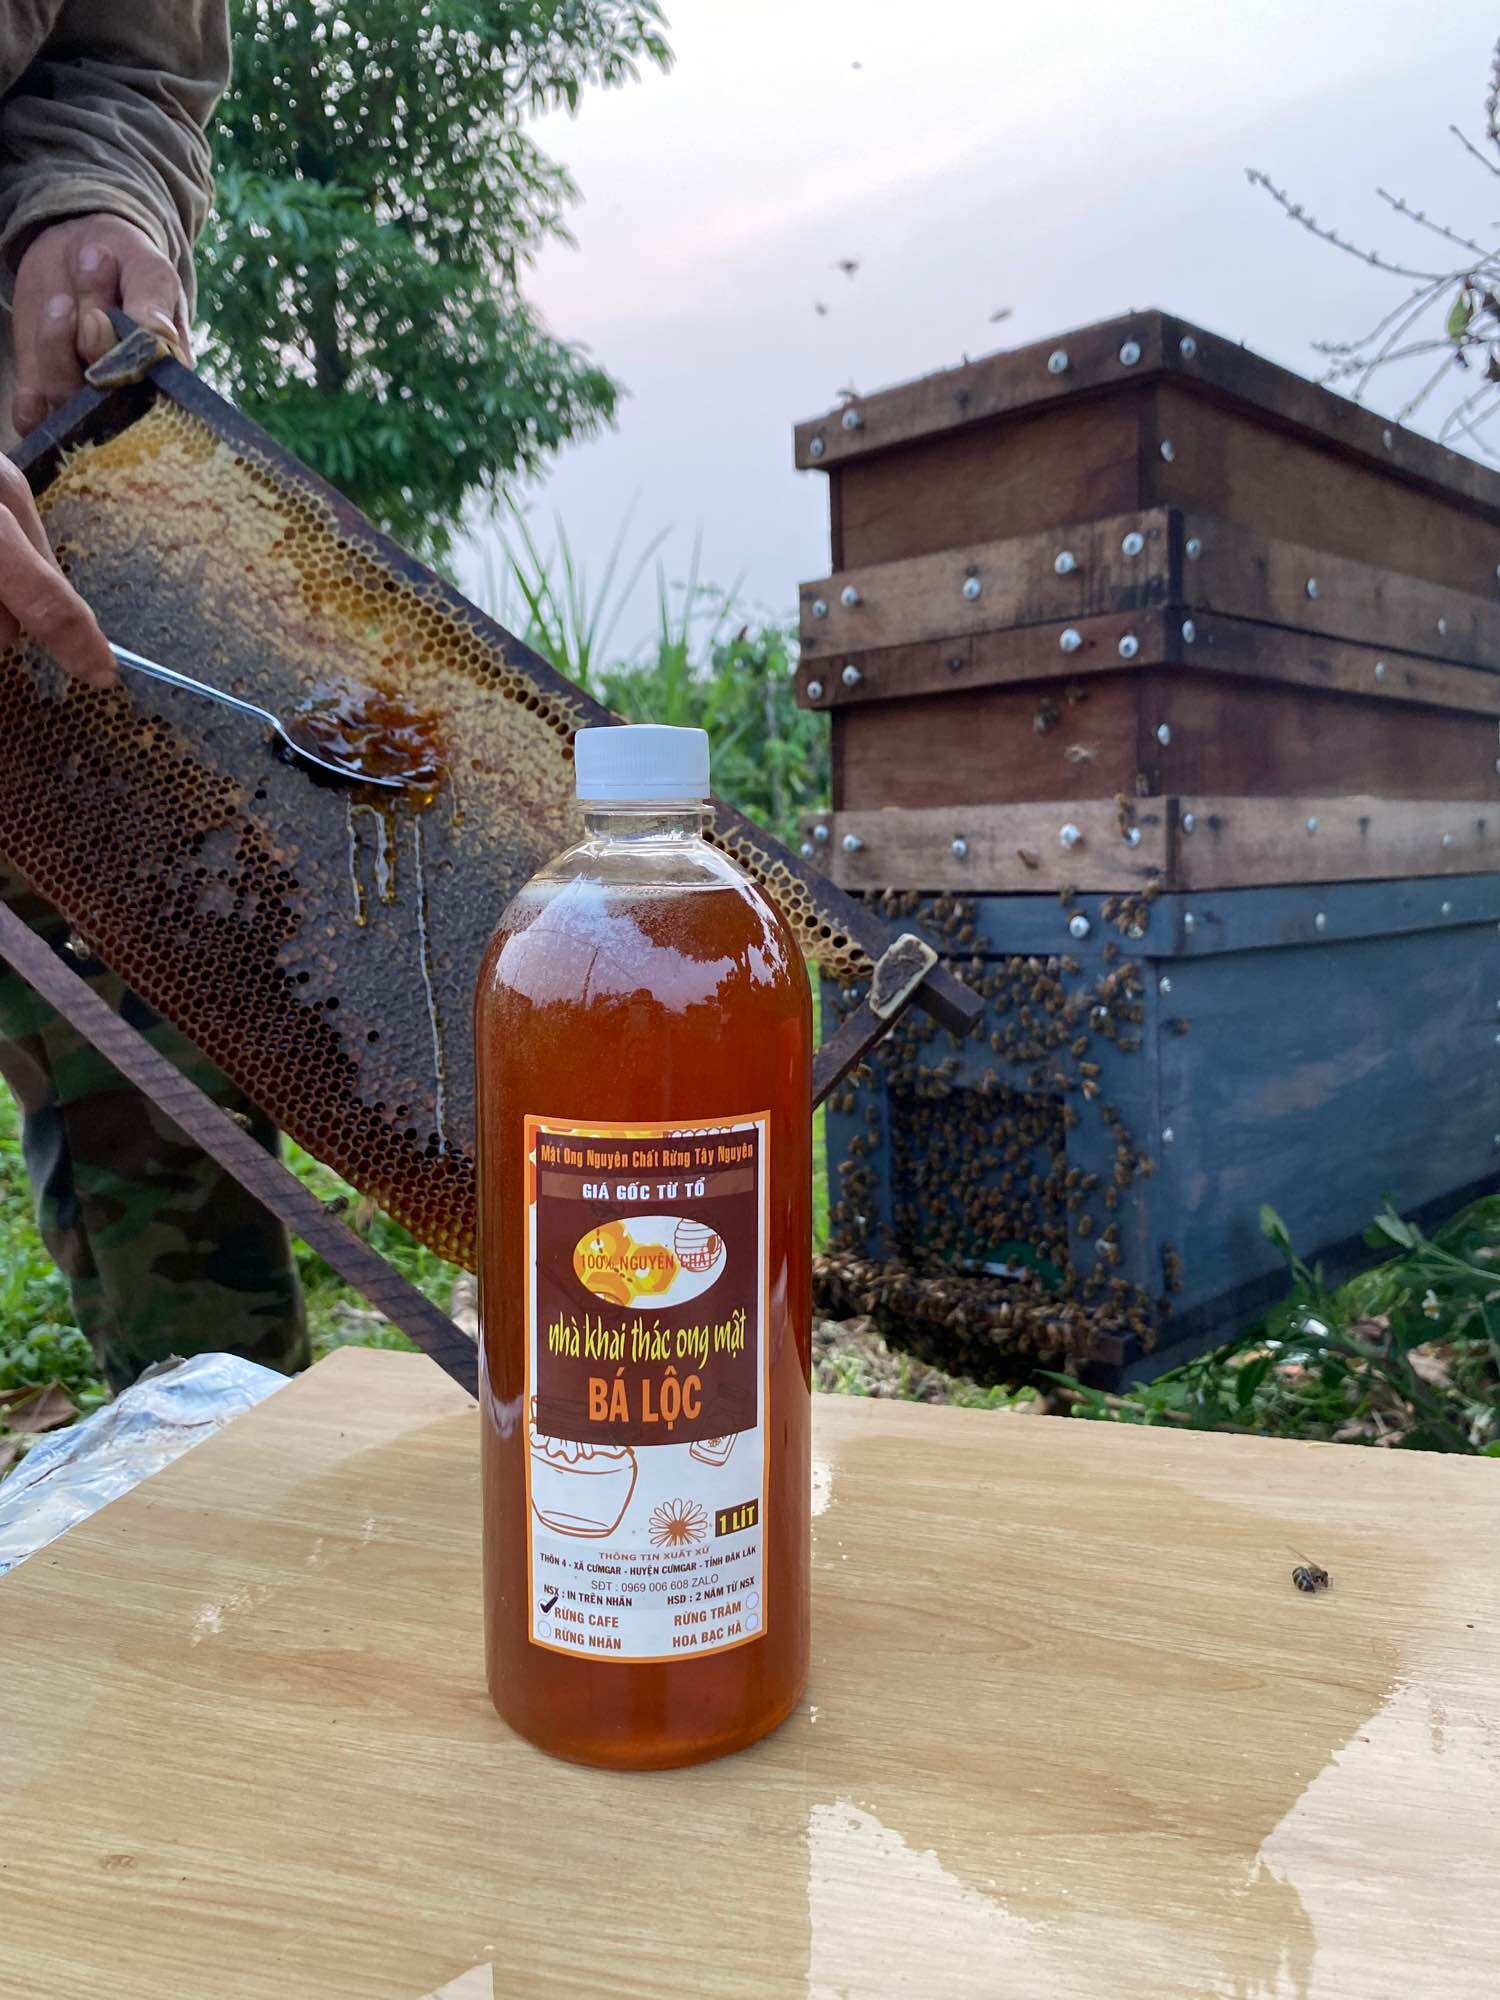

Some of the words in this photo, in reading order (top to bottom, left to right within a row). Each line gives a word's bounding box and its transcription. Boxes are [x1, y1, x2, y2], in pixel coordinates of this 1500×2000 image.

[541, 1144, 561, 1166] Mật
[563, 1147, 583, 1168] Ong
[586, 1149, 629, 1170] Nguyên
[632, 1149, 659, 1168] Chất
[662, 1149, 691, 1169] Rừng
[694, 1148, 715, 1167] Tây
[717, 1142, 753, 1164] Nguyên
[582, 1181, 610, 1200] GIÁ
[616, 1181, 650, 1201] GỐC
[656, 1181, 679, 1200] TỪ
[581, 1254, 614, 1270] 100%
[619, 1252, 675, 1271] NGUYÊN
[549, 1312, 580, 1358] nhà
[585, 1313, 627, 1361] khai
[630, 1316, 671, 1363] thác
[676, 1324, 710, 1370] ong
[714, 1307, 747, 1359] mật
[588, 1367, 630, 1423] BÁ
[642, 1365, 702, 1431] LỘC
[720, 1514, 727, 1534] 1
[732, 1505, 755, 1530] LÍT
[540, 1552, 560, 1566] THÔN
[562, 1559, 567, 1567] 4
[630, 1565, 659, 1577] HUYỆN
[599, 1551, 637, 1561] THÔNG
[640, 1553, 660, 1561] TIN
[543, 1583, 560, 1597] NSX
[567, 1590, 576, 1600] IN
[579, 1592, 603, 1606] TRÊN
[591, 1580, 613, 1592] SĐT
[621, 1582, 646, 1592] 0969
[649, 1581, 668, 1592] 006
[670, 1580, 689, 1590] 608
[691, 1573, 719, 1588] ZALO
[667, 1594, 686, 1606] HSD
[695, 1592, 702, 1601] 2
[740, 1575, 756, 1589] NSX
[588, 1614, 619, 1628] CAFE
[672, 1633, 698, 1648] HOA
[701, 1627, 724, 1644] BẠC
[727, 1619, 743, 1637] HÀ
